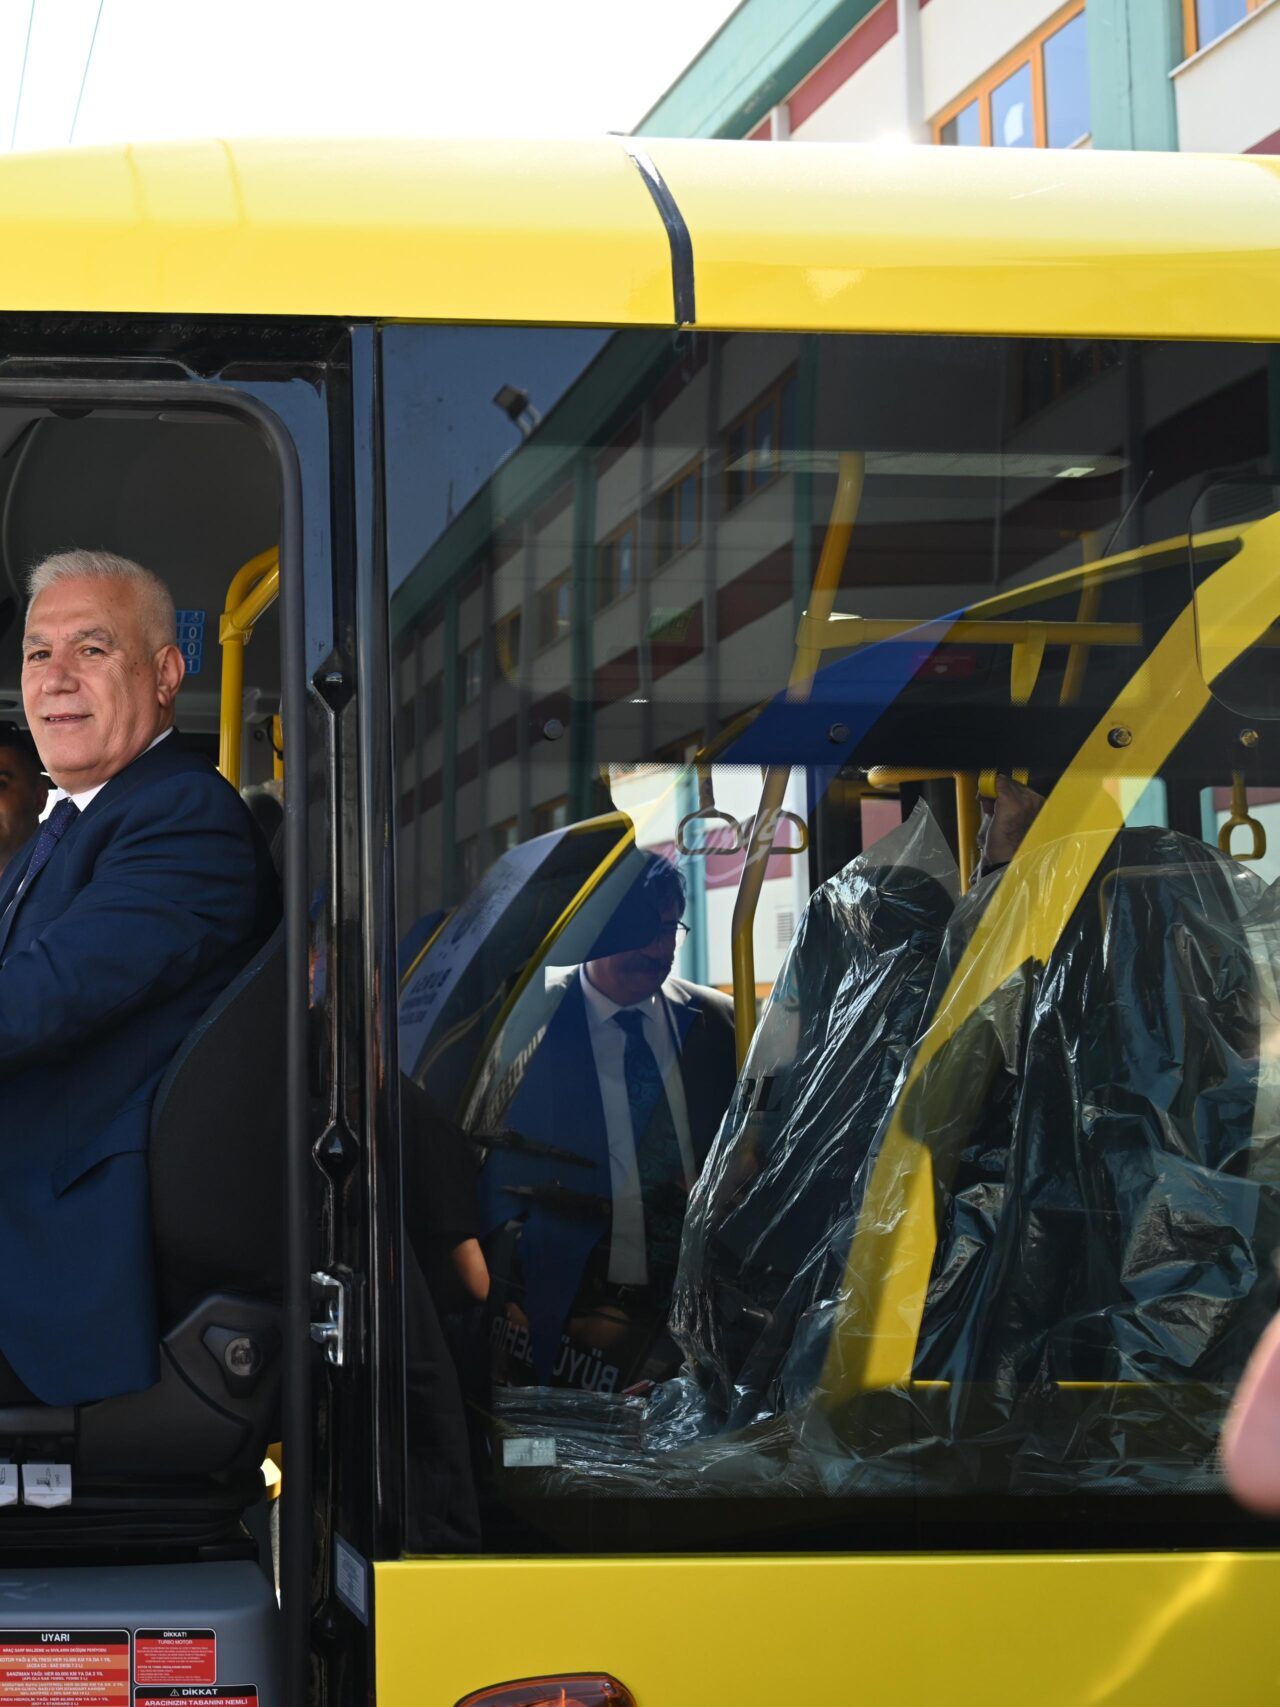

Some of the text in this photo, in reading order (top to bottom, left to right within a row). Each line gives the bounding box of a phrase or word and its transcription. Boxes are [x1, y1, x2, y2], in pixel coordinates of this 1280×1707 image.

[41, 1633, 70, 1642] UYARI
[182, 1688, 218, 1696] DİKKAT
[225, 1697, 248, 1705] NEMLİ
